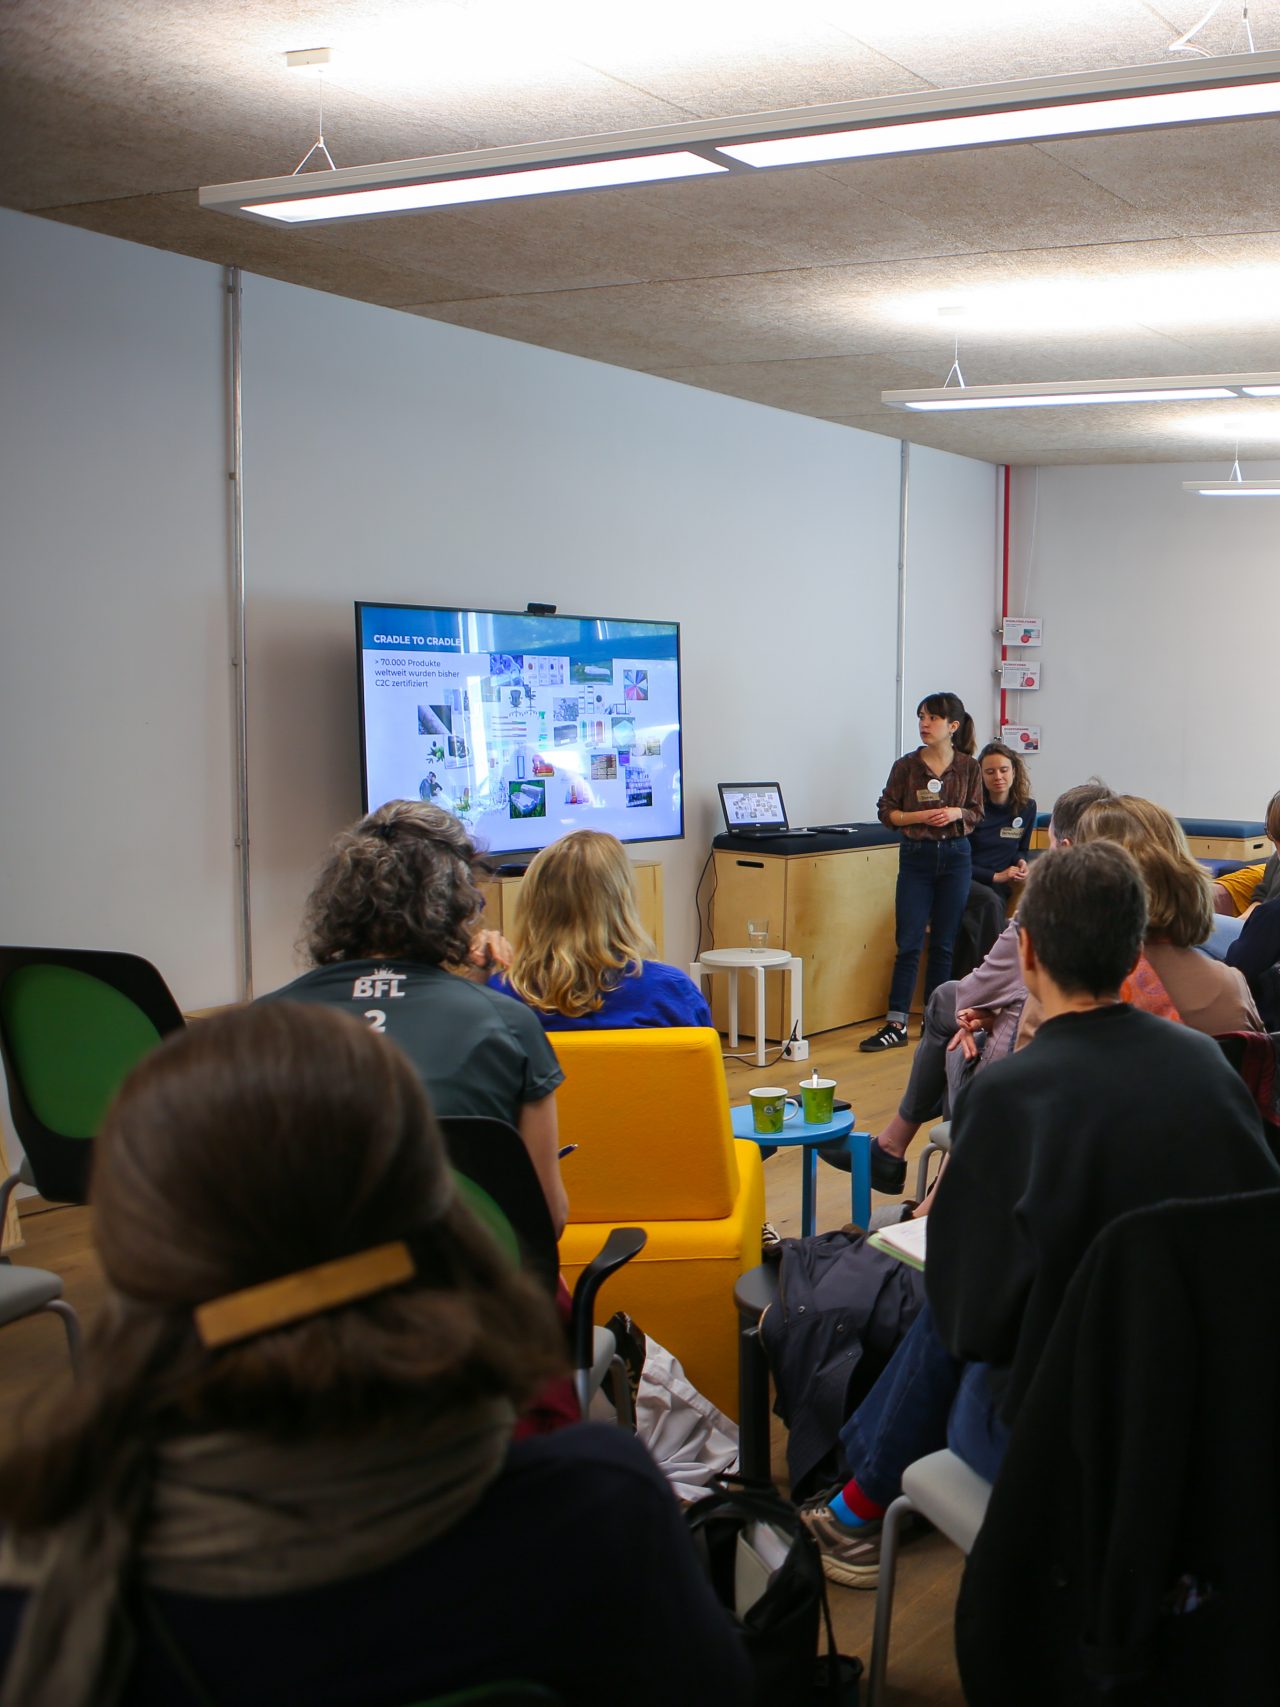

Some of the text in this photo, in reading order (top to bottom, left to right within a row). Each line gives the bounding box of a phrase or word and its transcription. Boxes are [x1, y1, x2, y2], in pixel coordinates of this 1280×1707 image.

[374, 634, 461, 646] CRADLE TO CRADLE
[381, 658, 406, 666] 70.000
[407, 659, 441, 667] Produkte
[408, 669, 436, 677] wurden
[437, 670, 460, 678] bisher
[375, 679, 429, 688] C2C zertifiziert
[353, 979, 405, 997] BFL
[364, 1009, 386, 1033] 2
